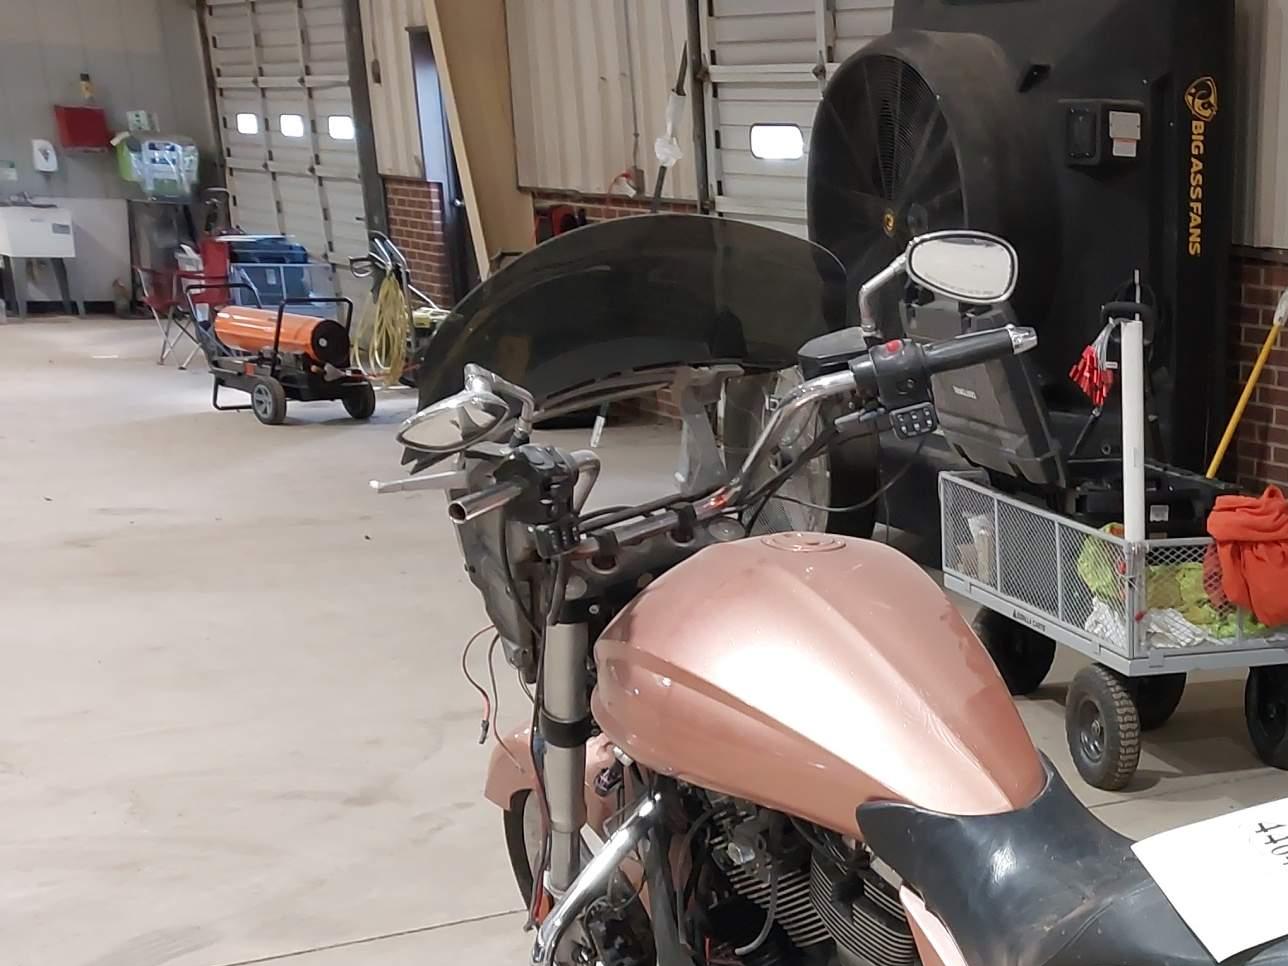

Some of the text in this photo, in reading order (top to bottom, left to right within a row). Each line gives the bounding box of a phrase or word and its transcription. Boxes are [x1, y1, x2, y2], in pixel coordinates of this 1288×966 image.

[1188, 120, 1205, 256] BIG ASS FANS
